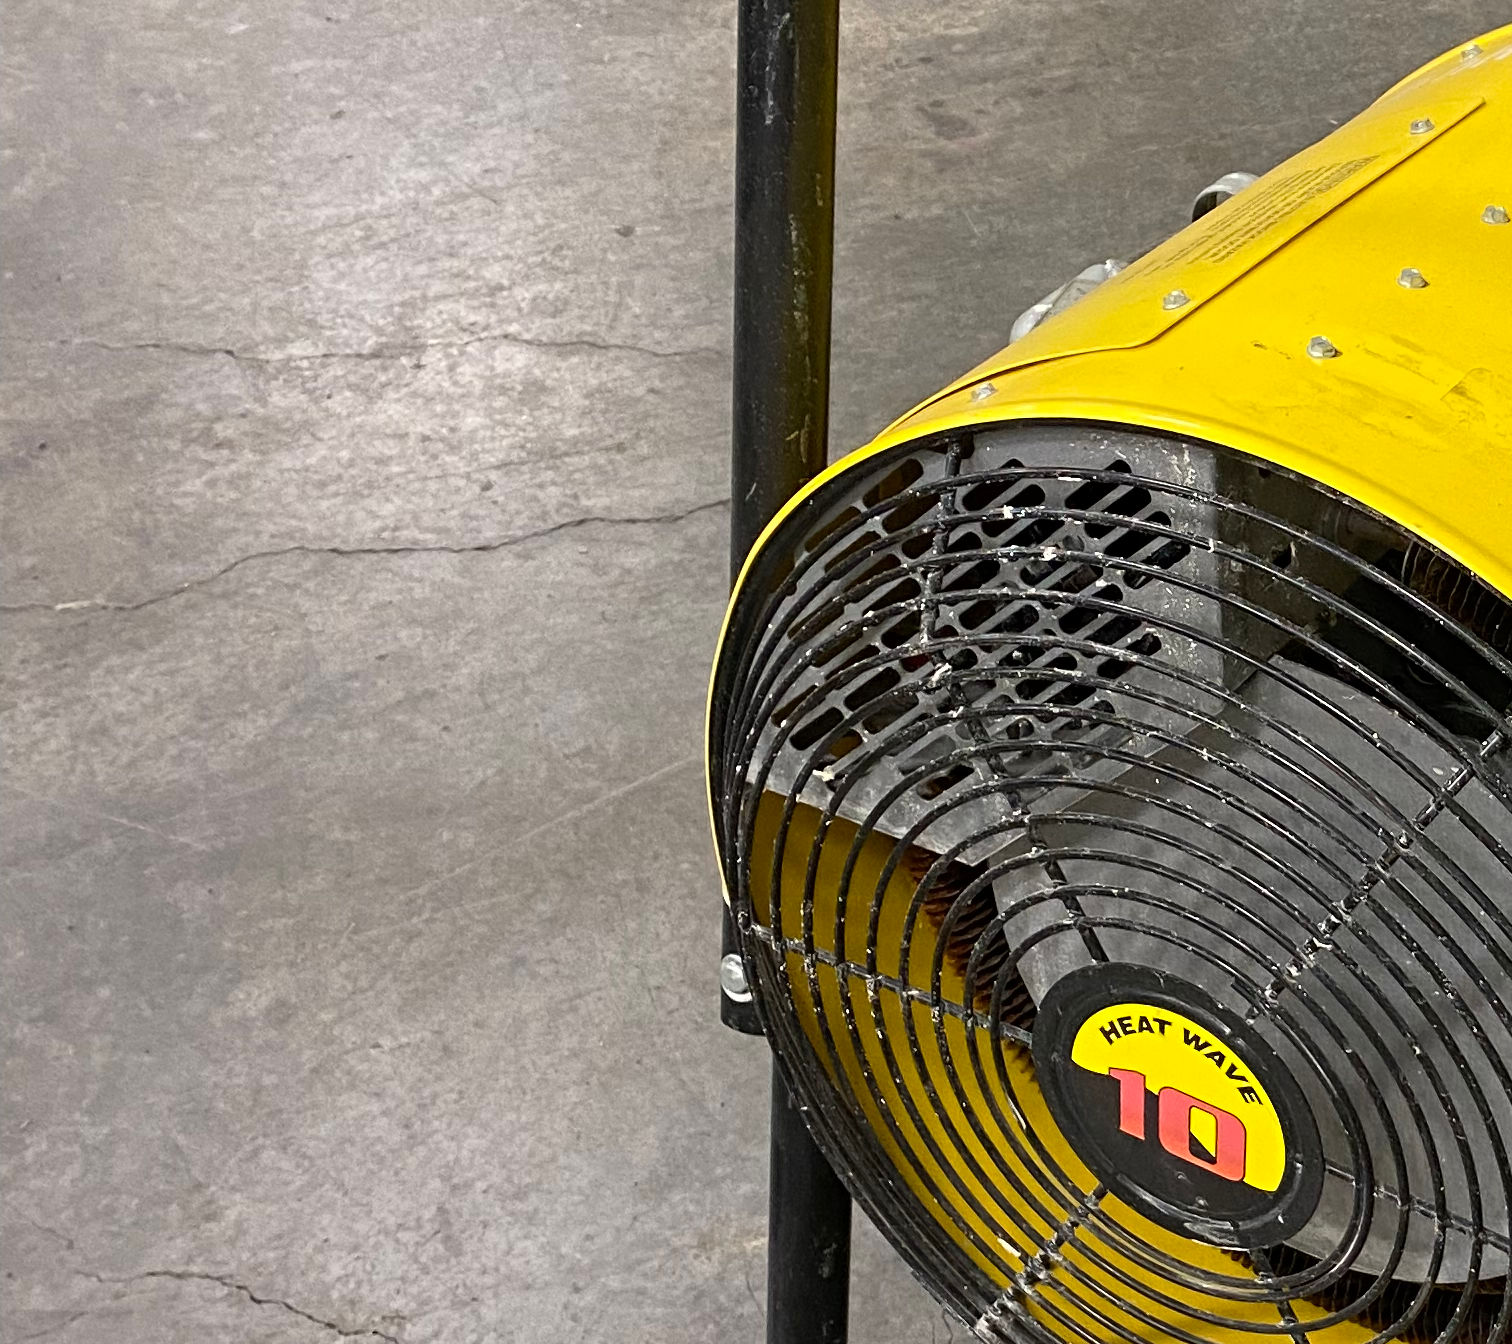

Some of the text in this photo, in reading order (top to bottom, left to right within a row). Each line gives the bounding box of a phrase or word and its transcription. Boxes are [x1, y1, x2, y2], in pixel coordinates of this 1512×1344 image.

[1098, 1015, 1264, 1106] HEAT WAVE
[1107, 1067, 1247, 1182] 10
